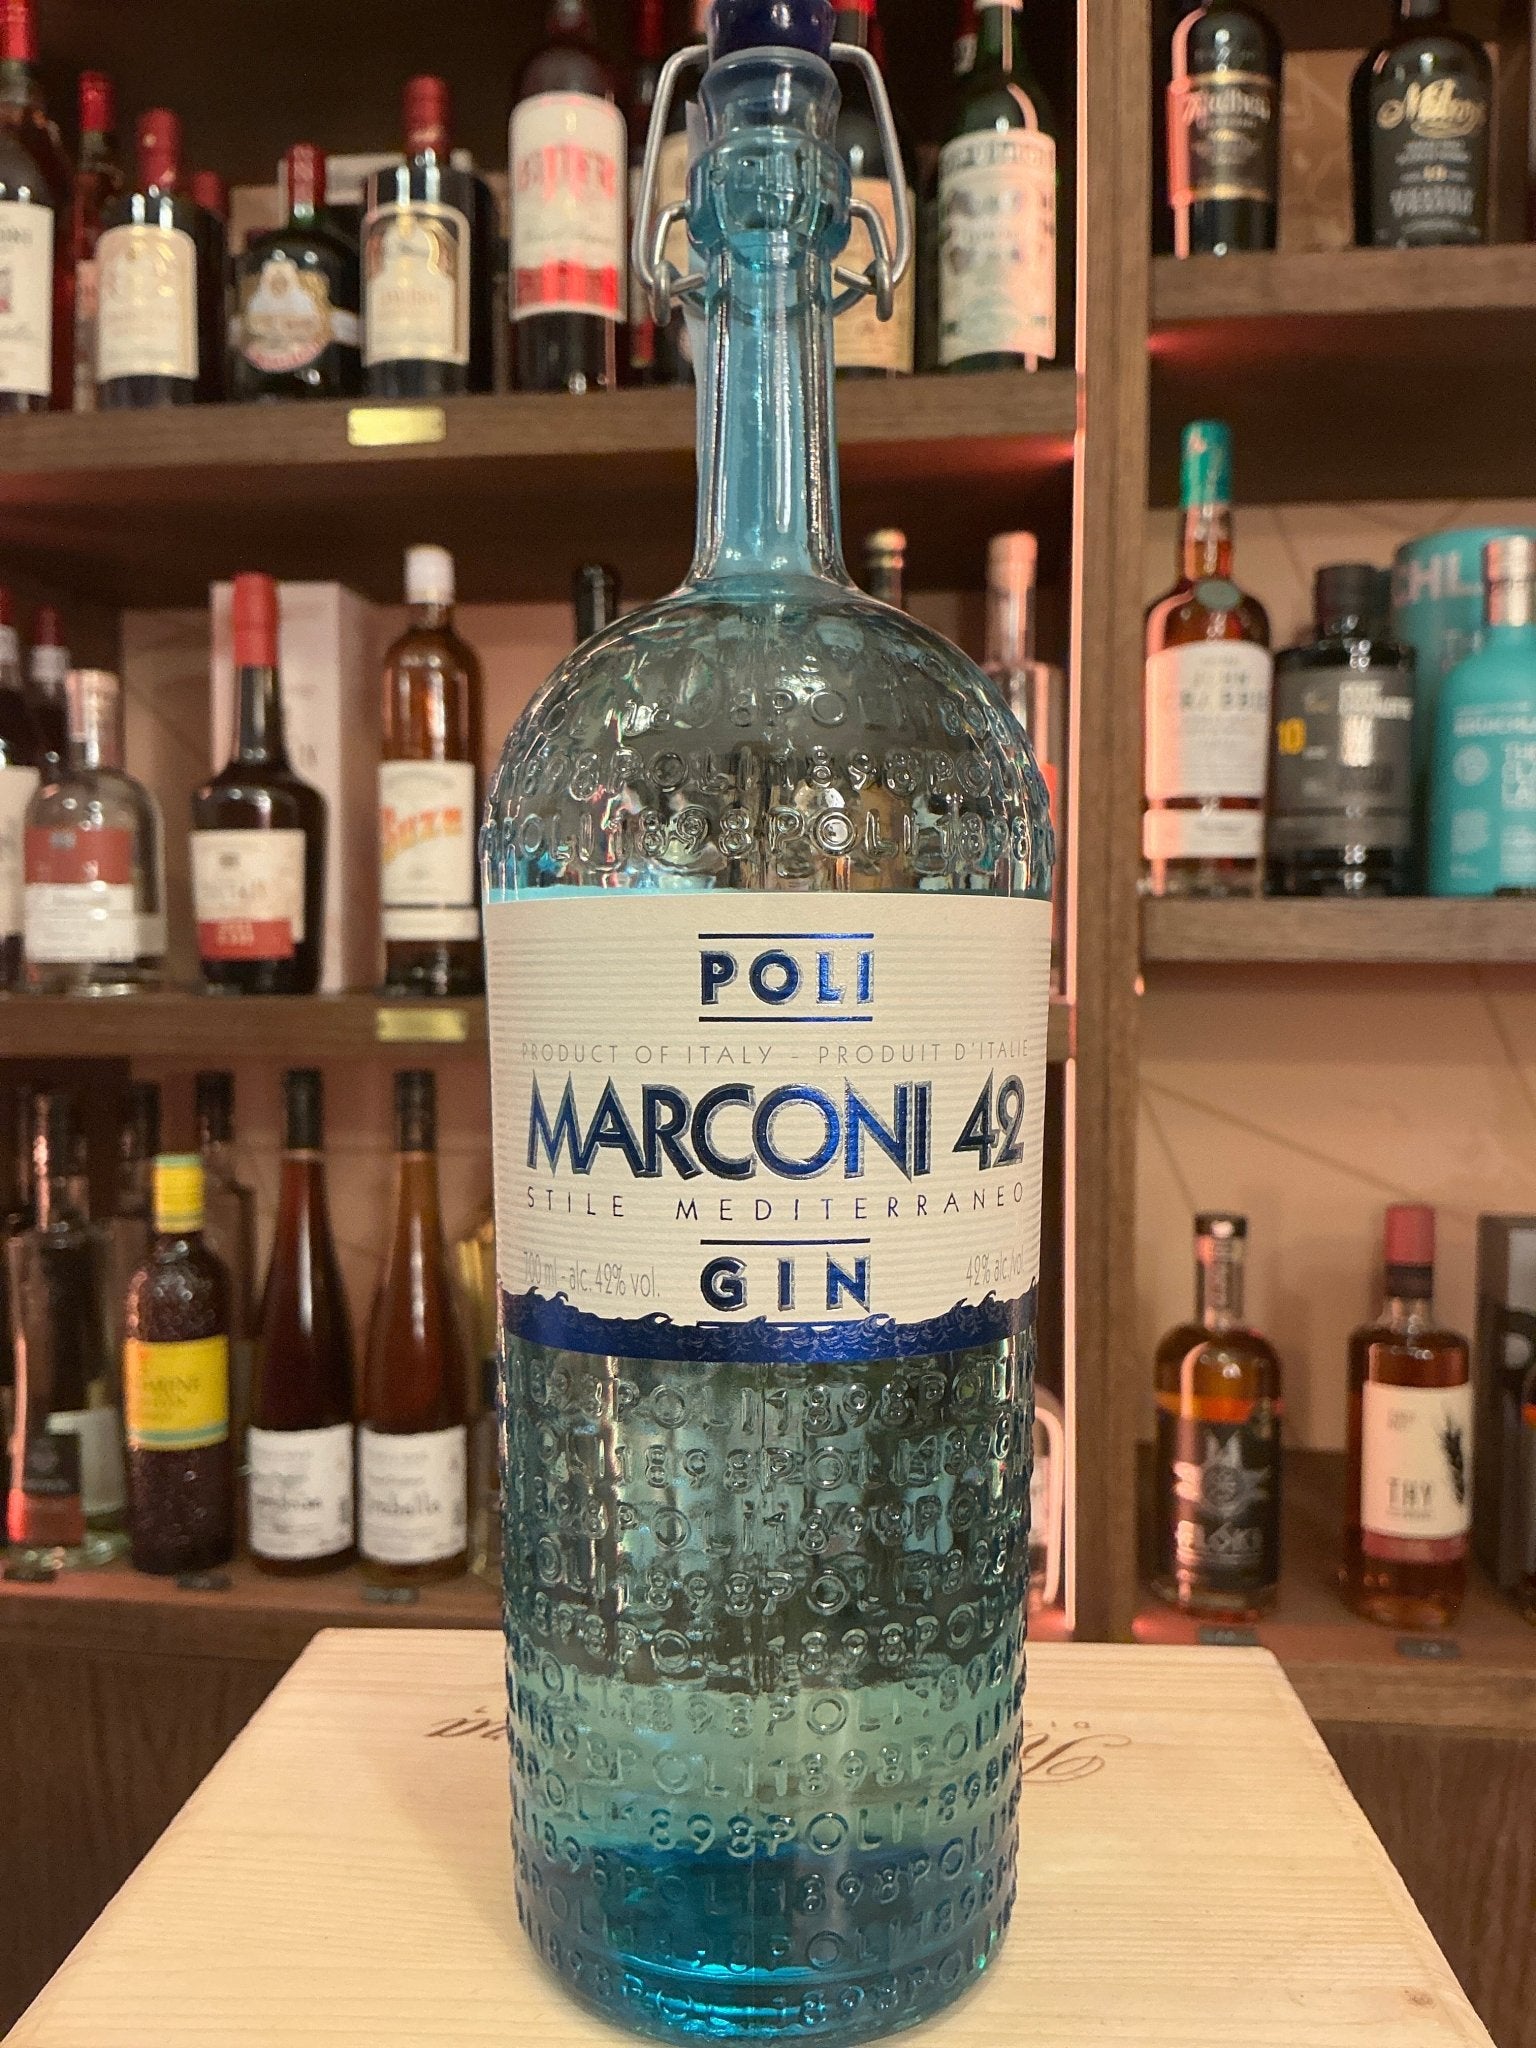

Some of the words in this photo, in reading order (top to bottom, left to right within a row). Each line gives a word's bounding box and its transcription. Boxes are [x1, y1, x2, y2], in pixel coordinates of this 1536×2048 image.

[698, 948, 875, 1006] POLI
[520, 1042, 618, 1063] PRODUCT
[635, 1045, 669, 1064] OF
[687, 1045, 772, 1064] ITALY
[818, 1042, 941, 1064] PRODUIT
[955, 1039, 1028, 1061] D'ITALIE
[525, 1070, 933, 1182] MARCONI
[951, 1067, 1026, 1171] 42
[527, 1186, 625, 1217] STILE
[675, 1181, 1024, 1221] MEDITERRANEO
[595, 1262, 626, 1296] 42%
[630, 1265, 660, 1297] vol.
[699, 1252, 871, 1313] GIN
[966, 1252, 991, 1287] 42%
